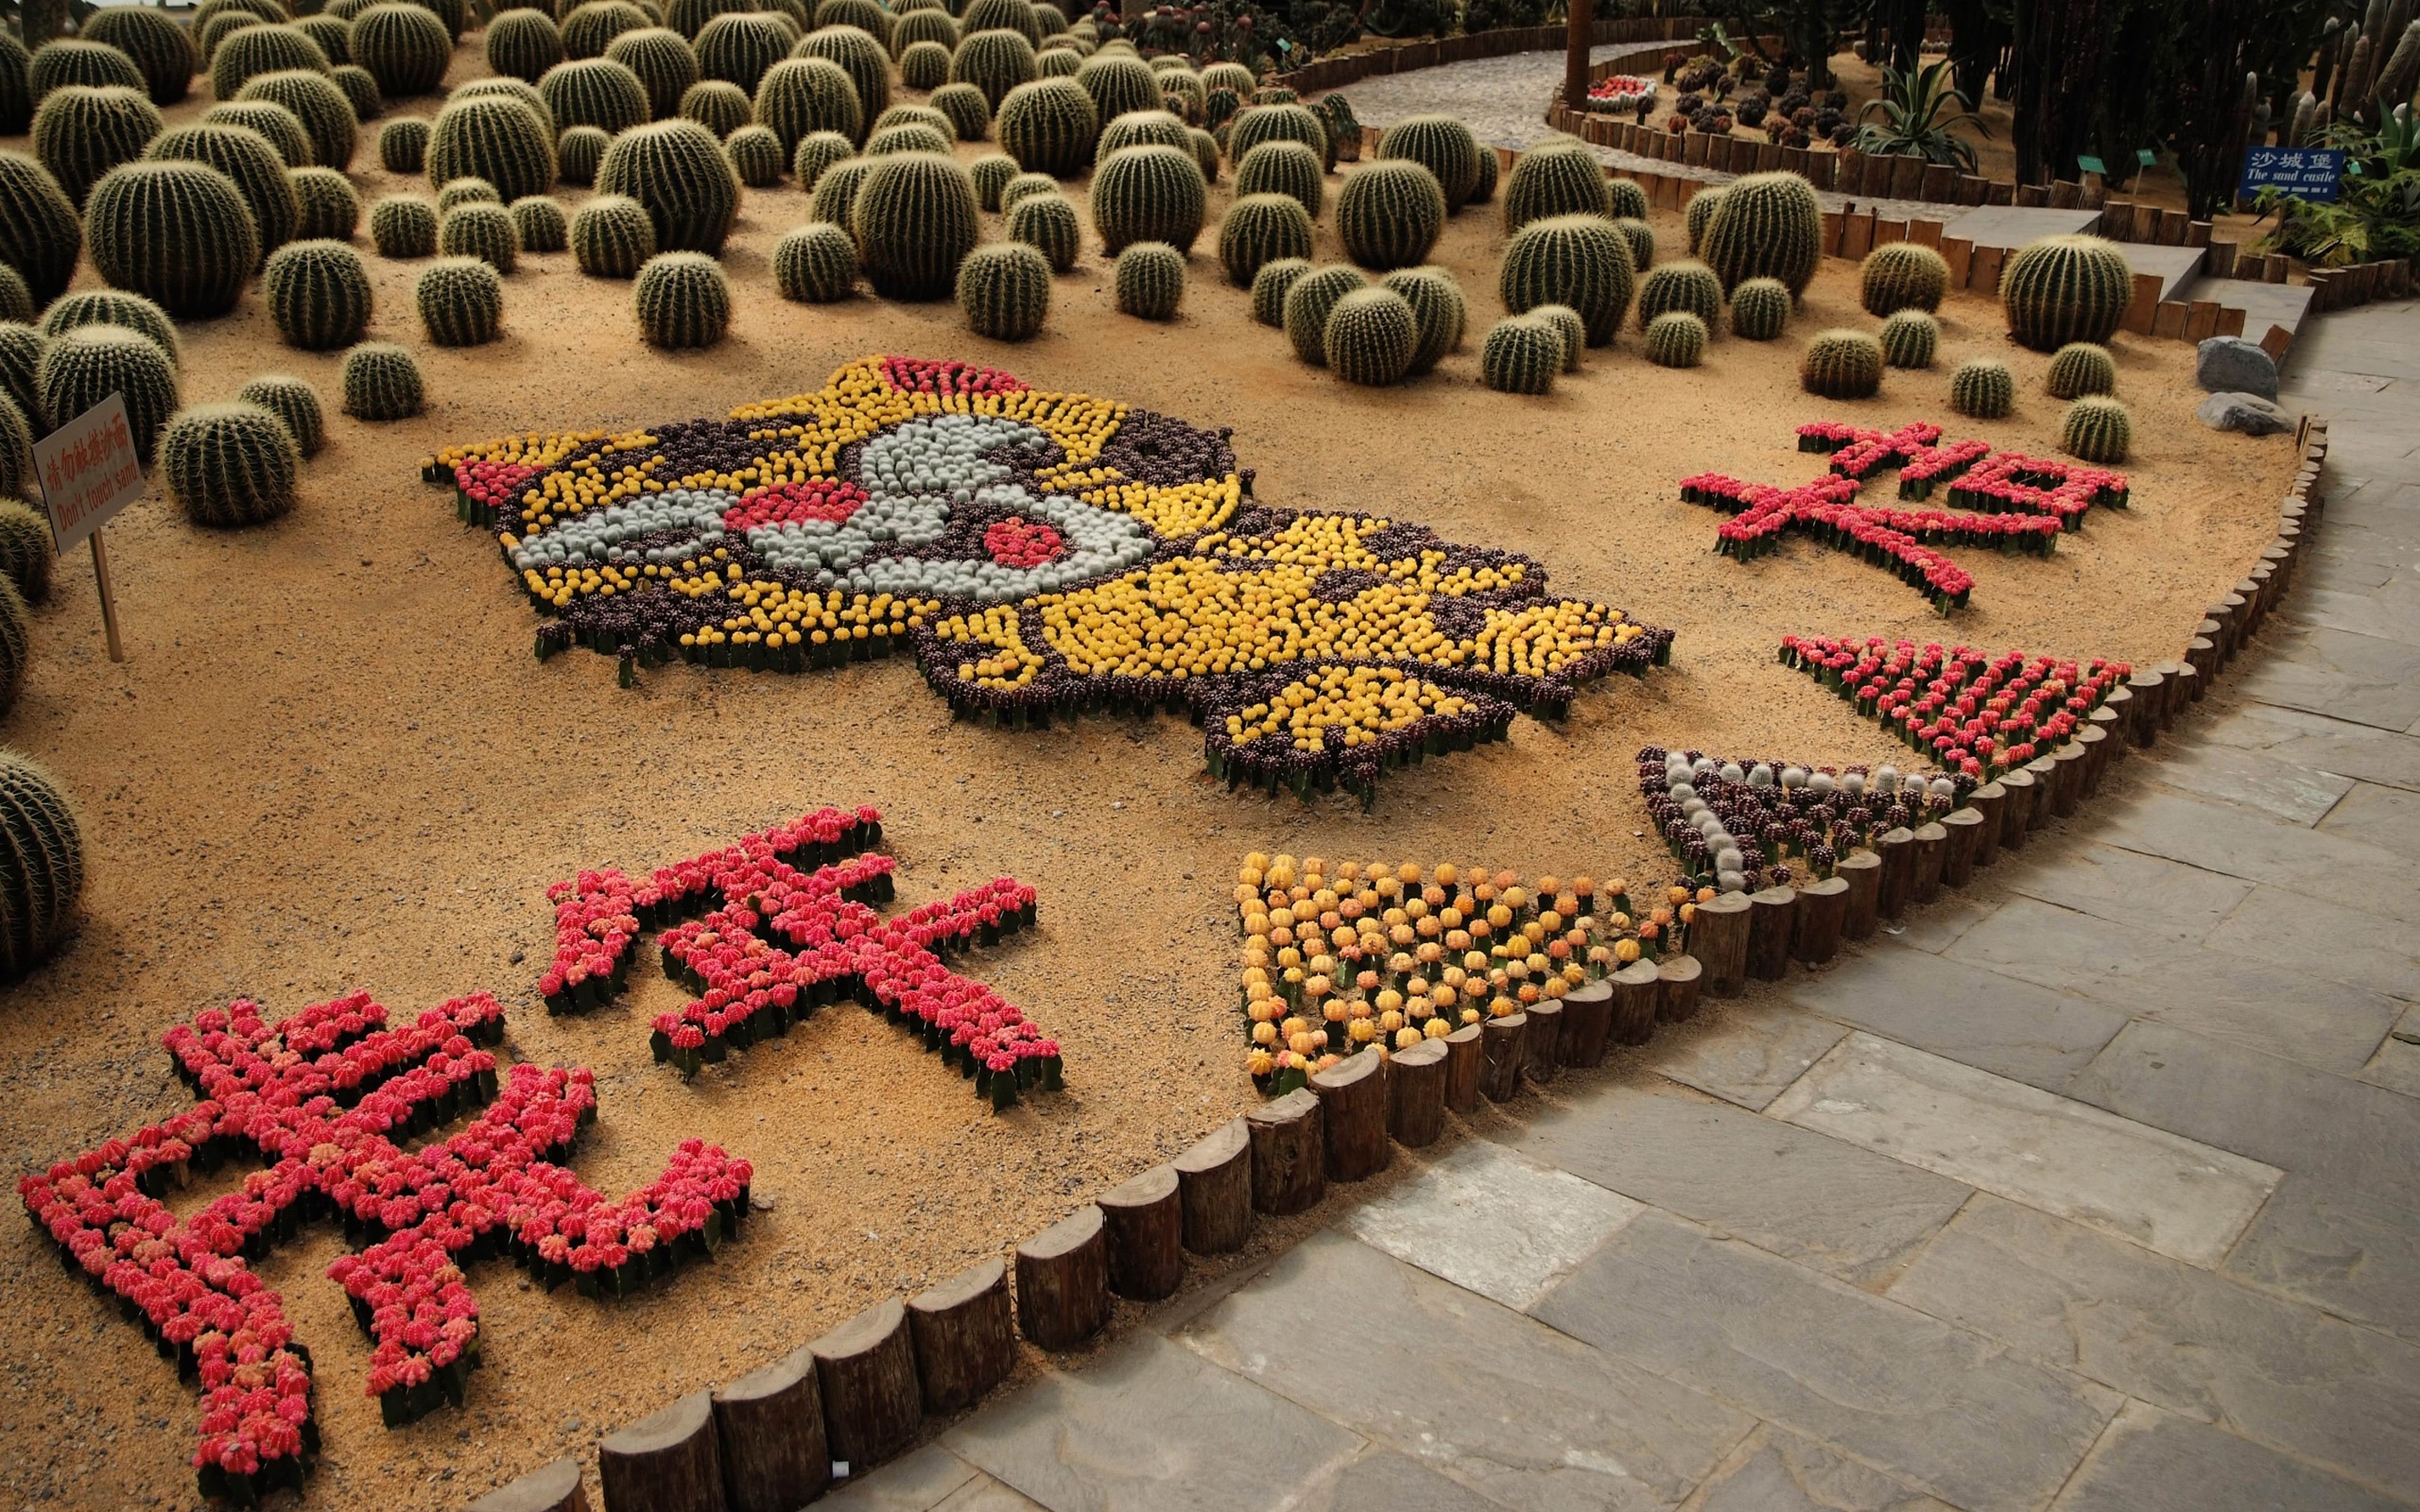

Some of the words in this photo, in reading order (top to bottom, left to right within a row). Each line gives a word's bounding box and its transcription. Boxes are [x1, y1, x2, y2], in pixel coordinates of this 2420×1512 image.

[2251, 151, 2333, 170] 沙城堡
[2247, 168, 2268, 180] The
[2272, 170, 2300, 182] sand
[2303, 171, 2335, 183] castle
[57, 491, 86, 533] Don't
[86, 472, 114, 512] touch
[115, 454, 138, 491] sand
